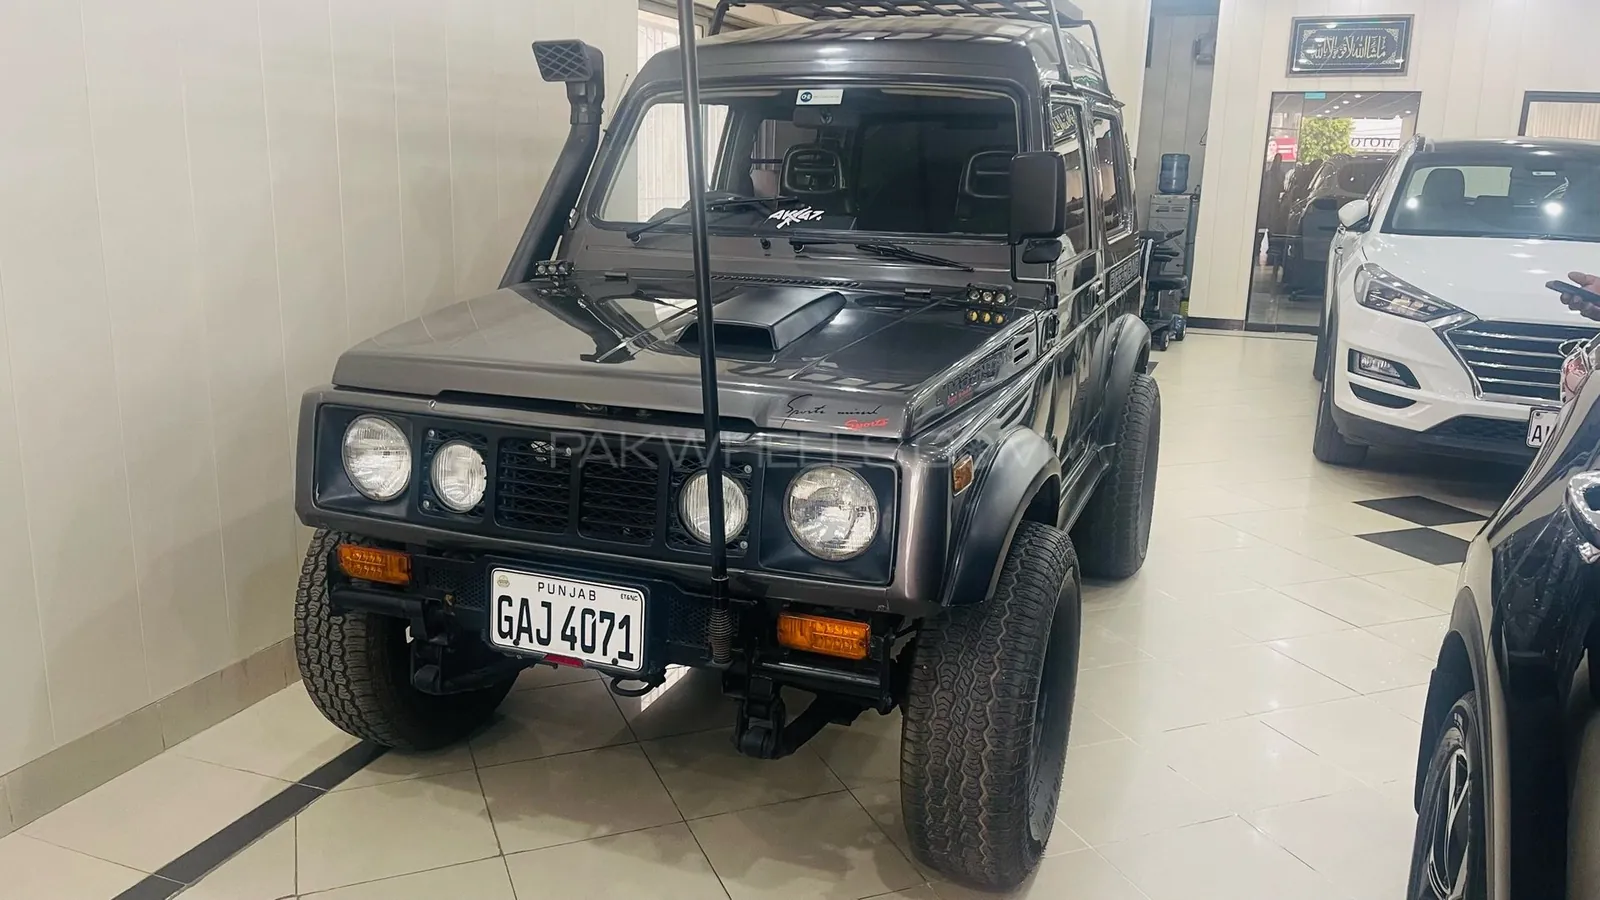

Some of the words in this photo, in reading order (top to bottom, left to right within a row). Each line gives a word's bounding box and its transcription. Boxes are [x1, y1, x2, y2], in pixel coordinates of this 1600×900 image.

[781, 393, 827, 428] Sports
[843, 418, 889, 431] Sports
[538, 581, 597, 602] PUNJAB
[497, 595, 552, 646] GAJ
[561, 606, 634, 662] 4071
